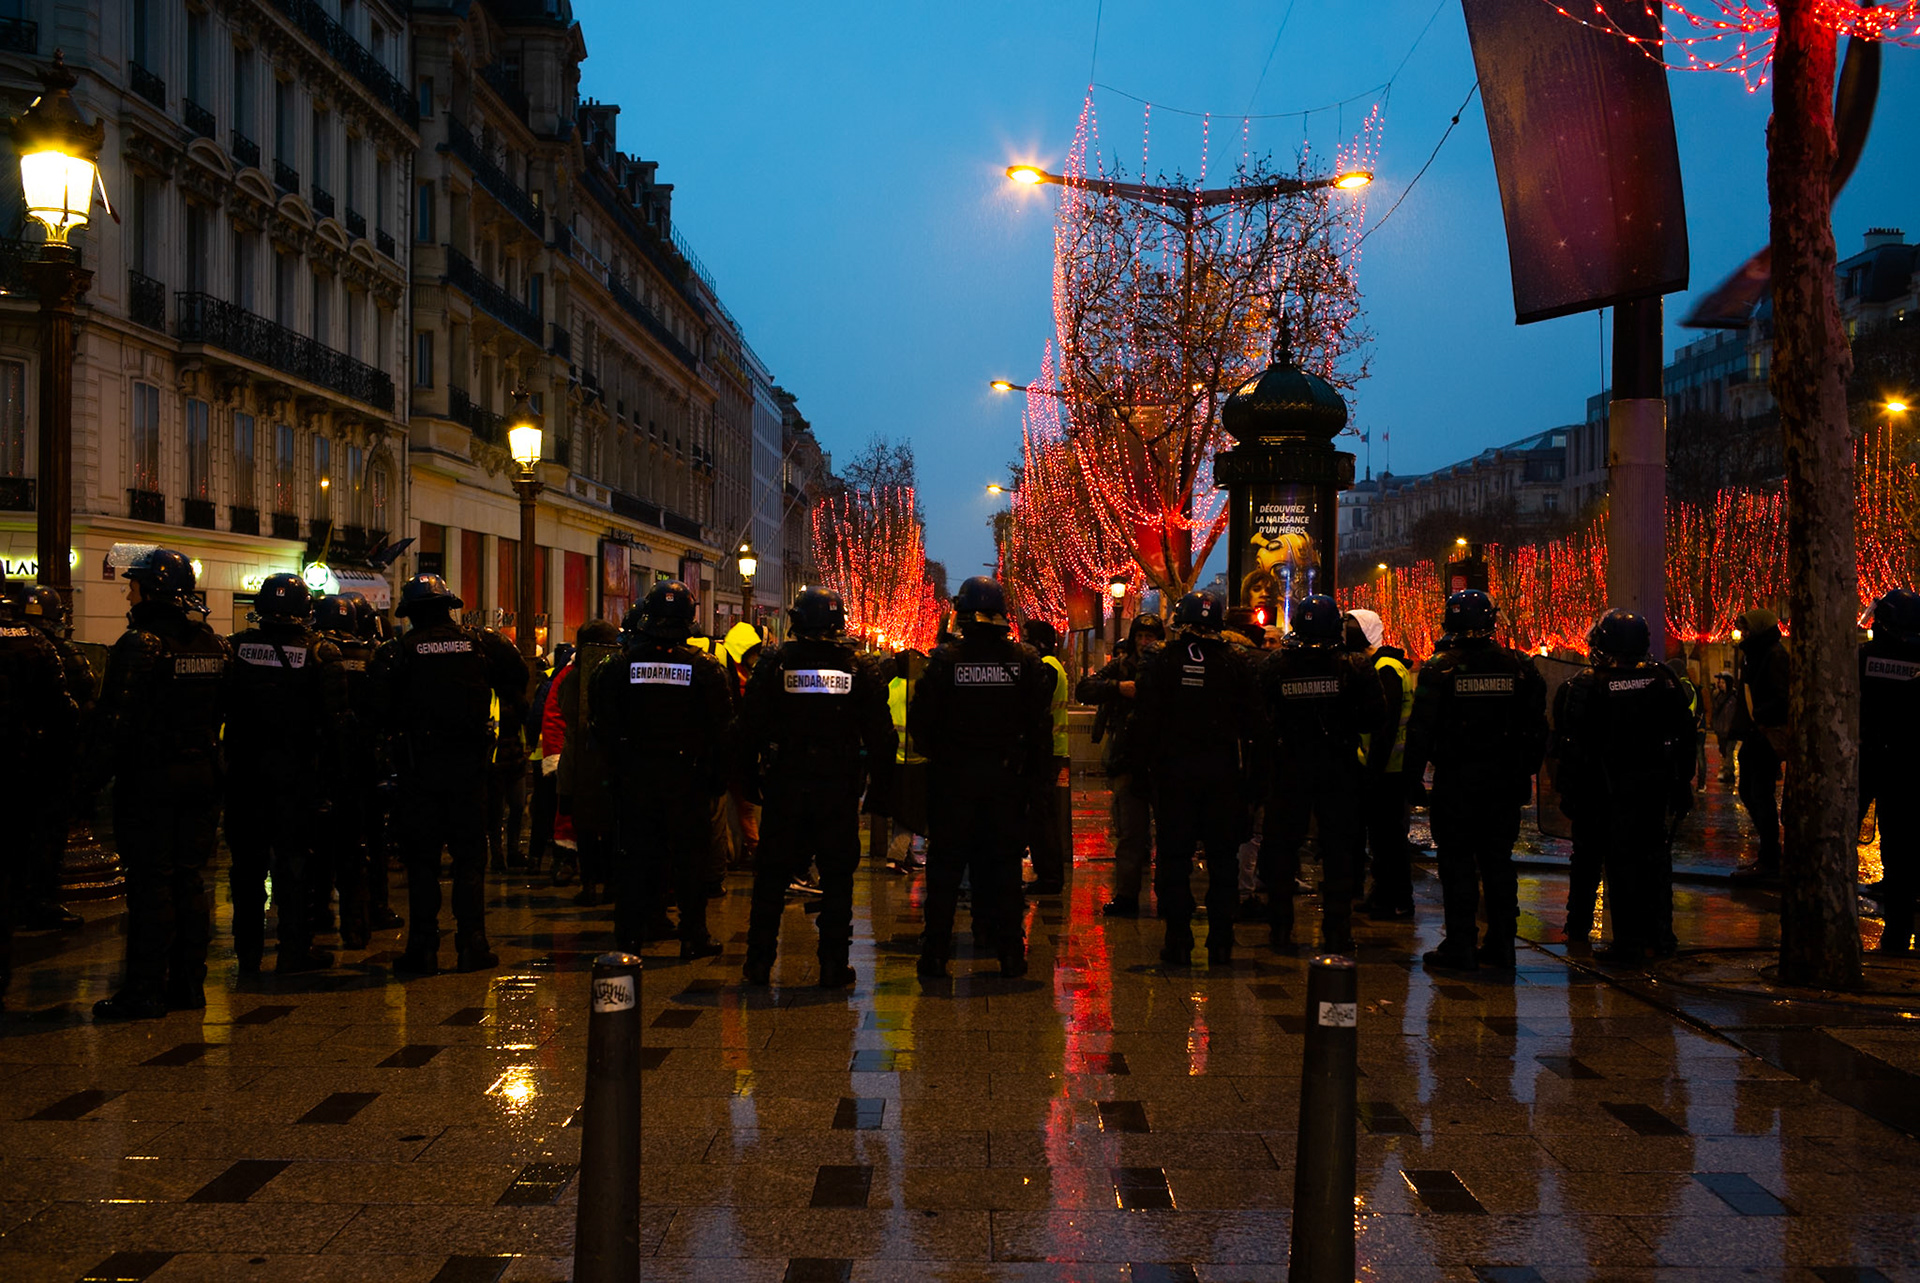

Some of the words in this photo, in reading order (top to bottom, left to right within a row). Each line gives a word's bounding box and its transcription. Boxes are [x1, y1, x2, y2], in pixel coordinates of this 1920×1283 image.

[1259, 503, 1306, 514] DÉCOUVREZ
[1255, 516, 1265, 524] LA
[1266, 516, 1310, 524] NAISSANCE
[1259, 526, 1278, 534] D'UN
[416, 640, 473, 655] GENDARMERIE
[631, 666, 691, 681] GENDARMERIE
[786, 674, 849, 689] GENDARMERIE
[1282, 680, 1340, 696] GENDARMERIE
[1456, 678, 1513, 692] GENDARMERIE
